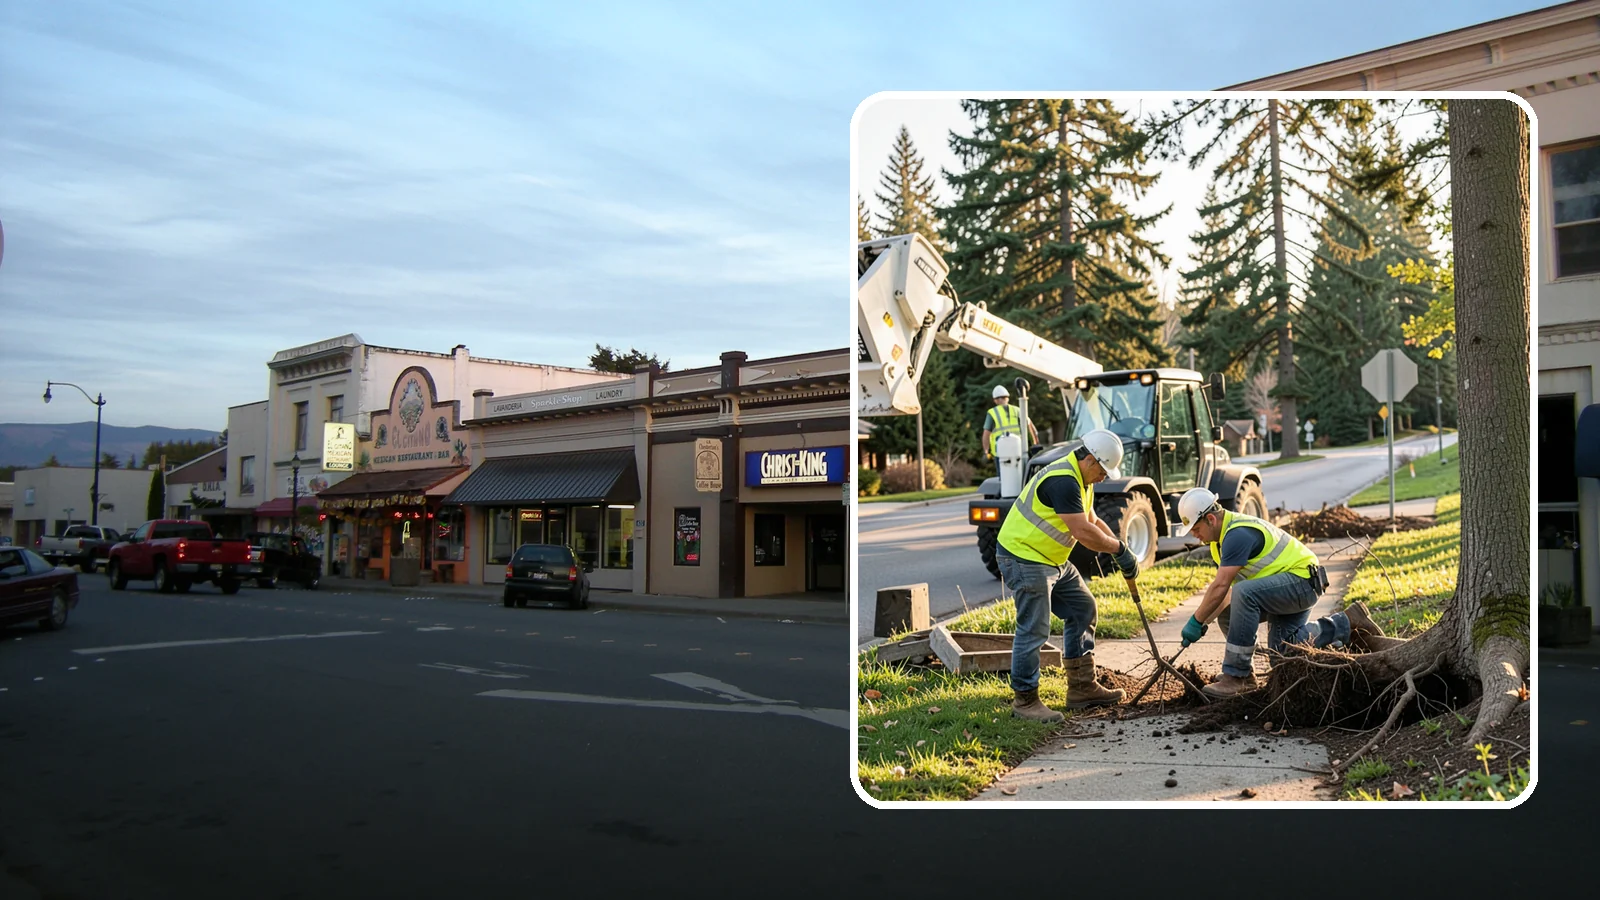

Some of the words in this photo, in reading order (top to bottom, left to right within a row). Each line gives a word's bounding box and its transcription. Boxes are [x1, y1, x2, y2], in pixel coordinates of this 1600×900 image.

[595, 389, 623, 400] LAUNDRY
[493, 402, 522, 412] LAVANDERIA
[531, 398, 560, 409] Sparkle
[562, 395, 582, 405] Shop
[373, 454, 396, 464] MEXICAN
[397, 451, 433, 463] RESTAURANT
[438, 450, 450, 459] BAR
[697, 481, 709, 489] Coffee
[710, 481, 722, 489] House
